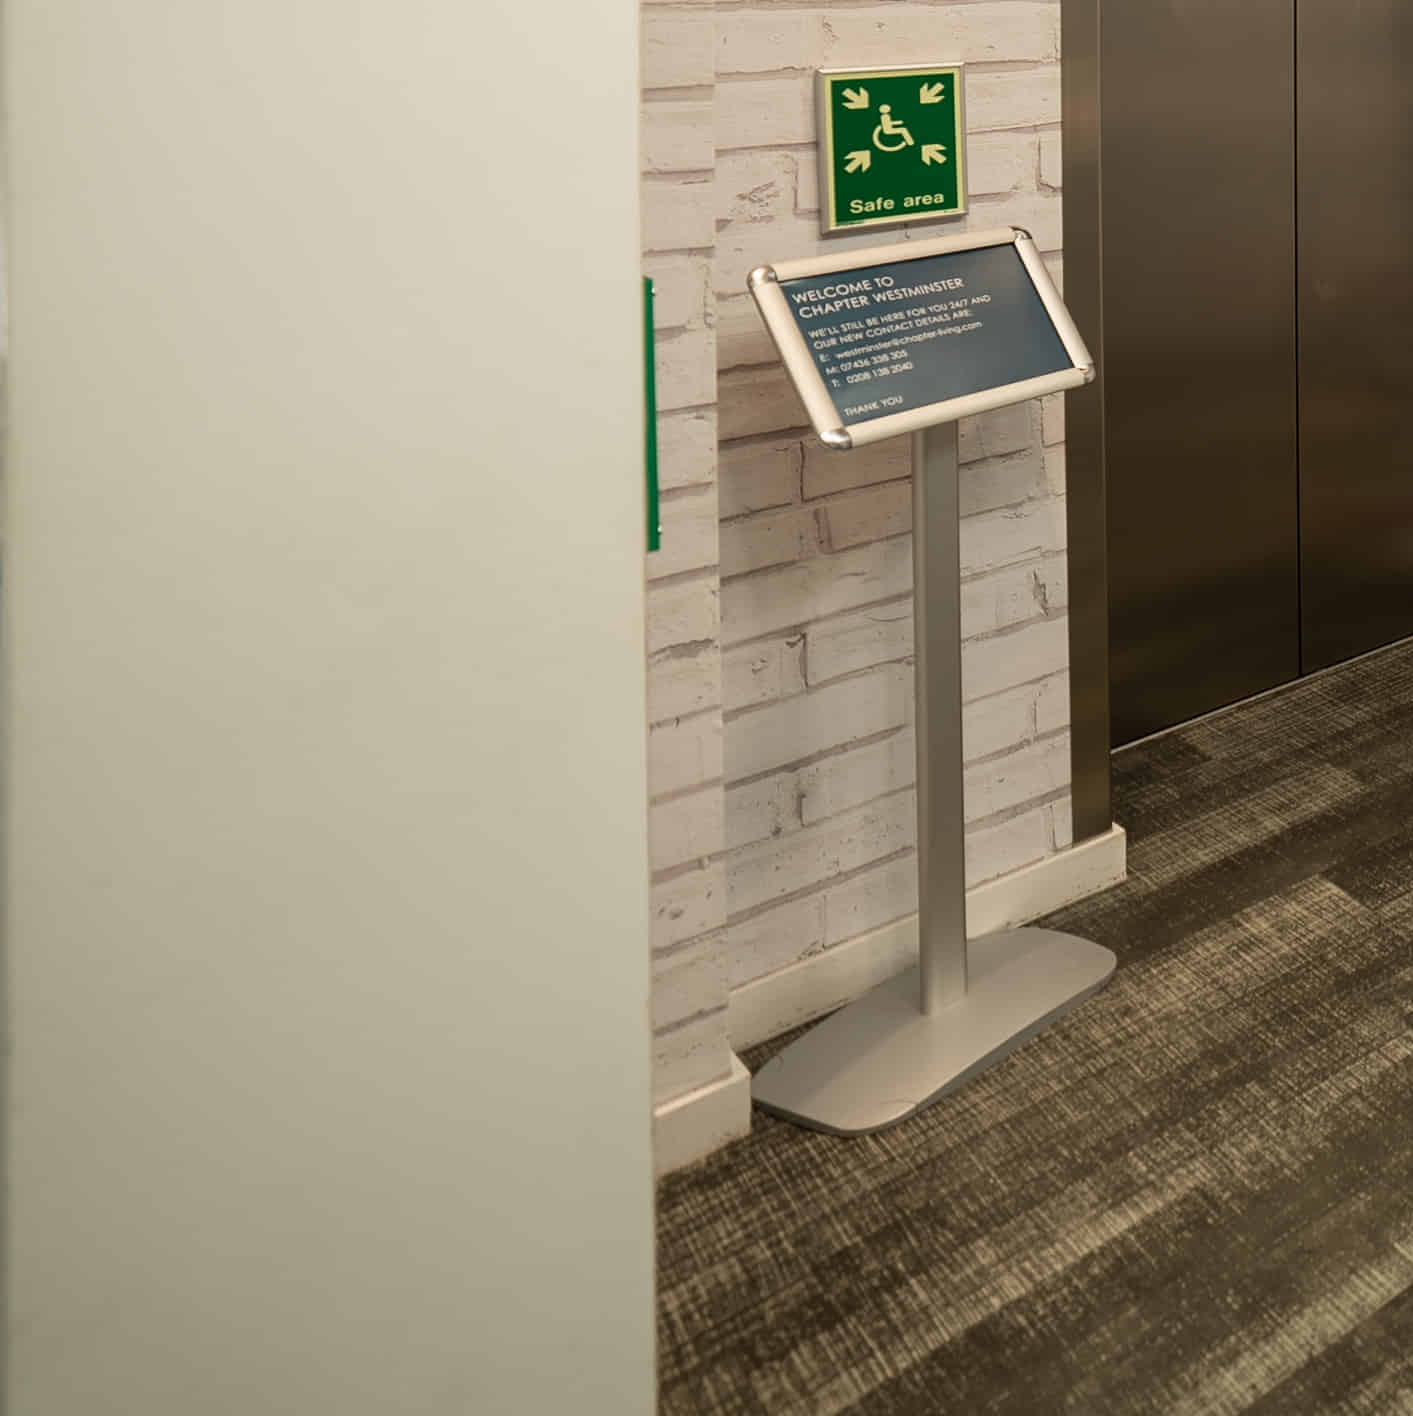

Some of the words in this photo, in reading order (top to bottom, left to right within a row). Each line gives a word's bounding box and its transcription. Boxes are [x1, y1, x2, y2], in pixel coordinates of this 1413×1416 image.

[849, 197, 895, 214] Safe
[903, 193, 945, 207] area
[791, 279, 873, 304] WELCOME
[873, 276, 895, 288] TO
[799, 296, 871, 319] CHAPTER
[872, 277, 965, 303] WESTMINSTER
[841, 321, 865, 333] STILL
[866, 318, 879, 327] BE
[880, 312, 905, 324] HERE
[906, 308, 927, 318] FOR
[928, 303, 948, 314] YOU
[970, 294, 992, 305] AND
[813, 339, 838, 350] OUR
[839, 332, 864, 344] NEW
[865, 321, 914, 338] CONTACT
[915, 315, 951, 328] DETAILS
[844, 401, 880, 417] THANK
[881, 395, 904, 407] YOU
